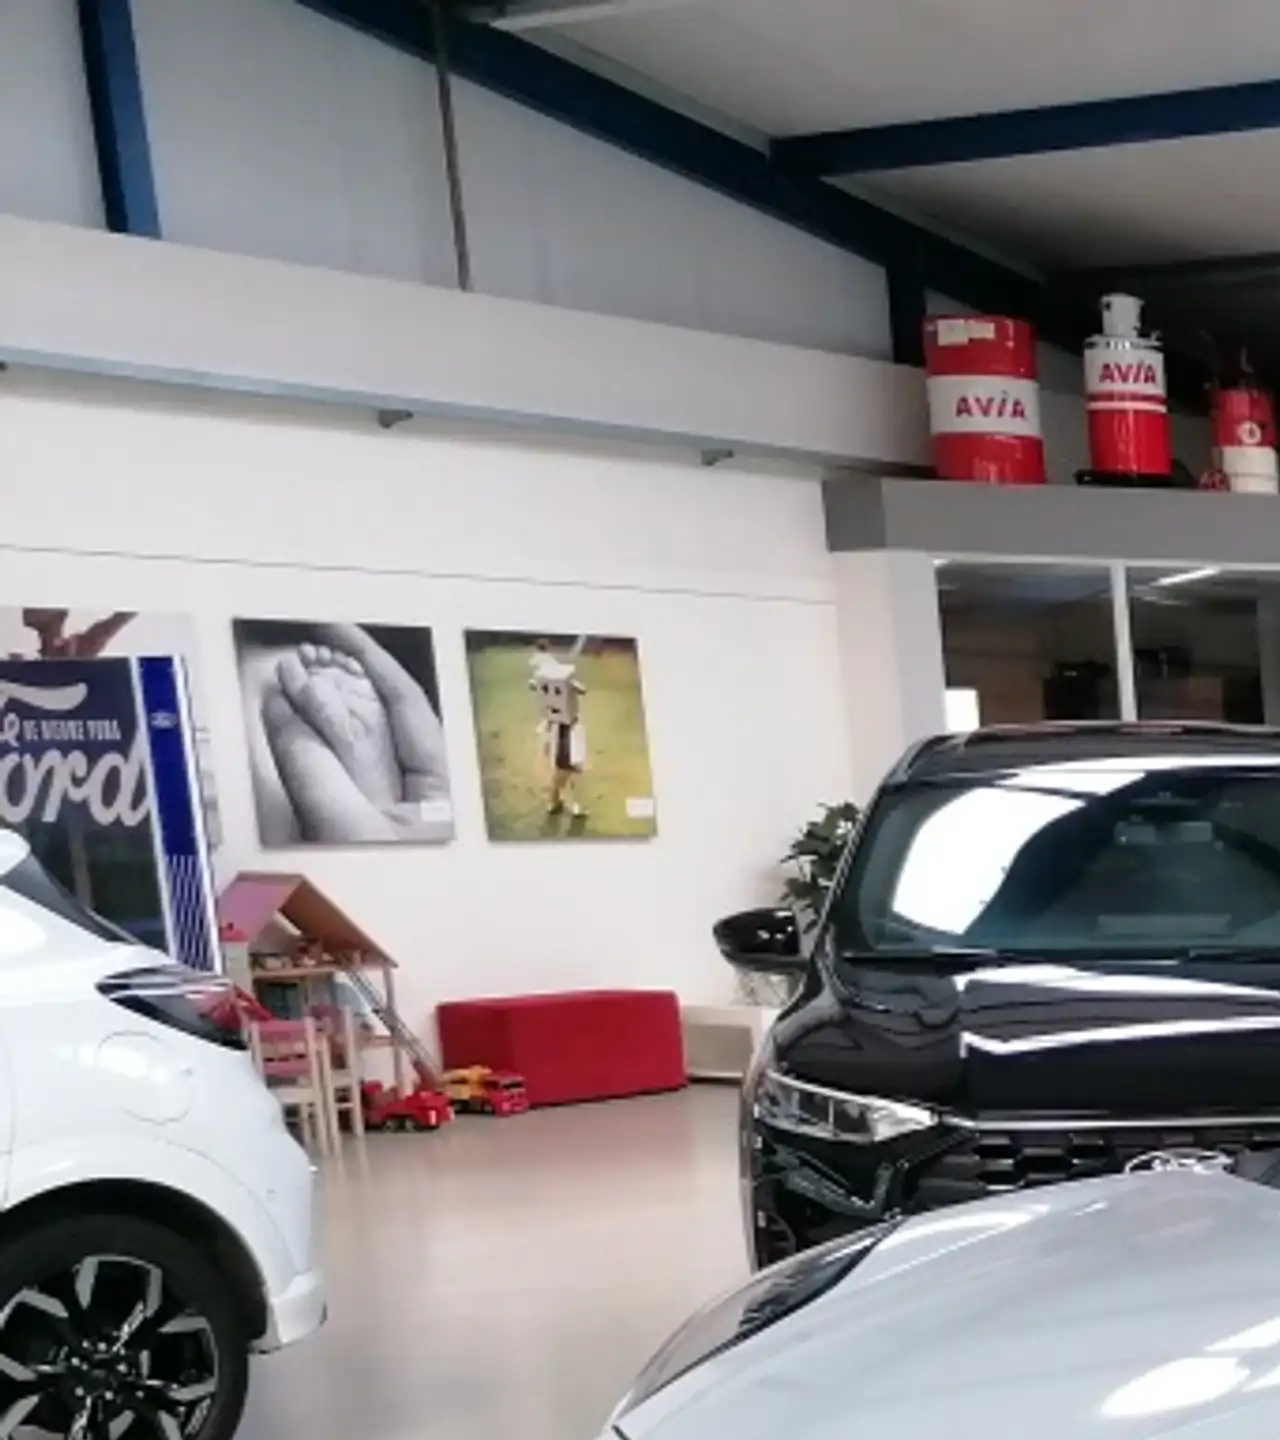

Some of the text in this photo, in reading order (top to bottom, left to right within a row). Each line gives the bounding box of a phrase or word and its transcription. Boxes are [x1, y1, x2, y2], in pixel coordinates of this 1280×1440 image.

[1099, 360, 1157, 385] AVIA
[955, 390, 1027, 421] AVIA
[0, 680, 152, 827] ord
